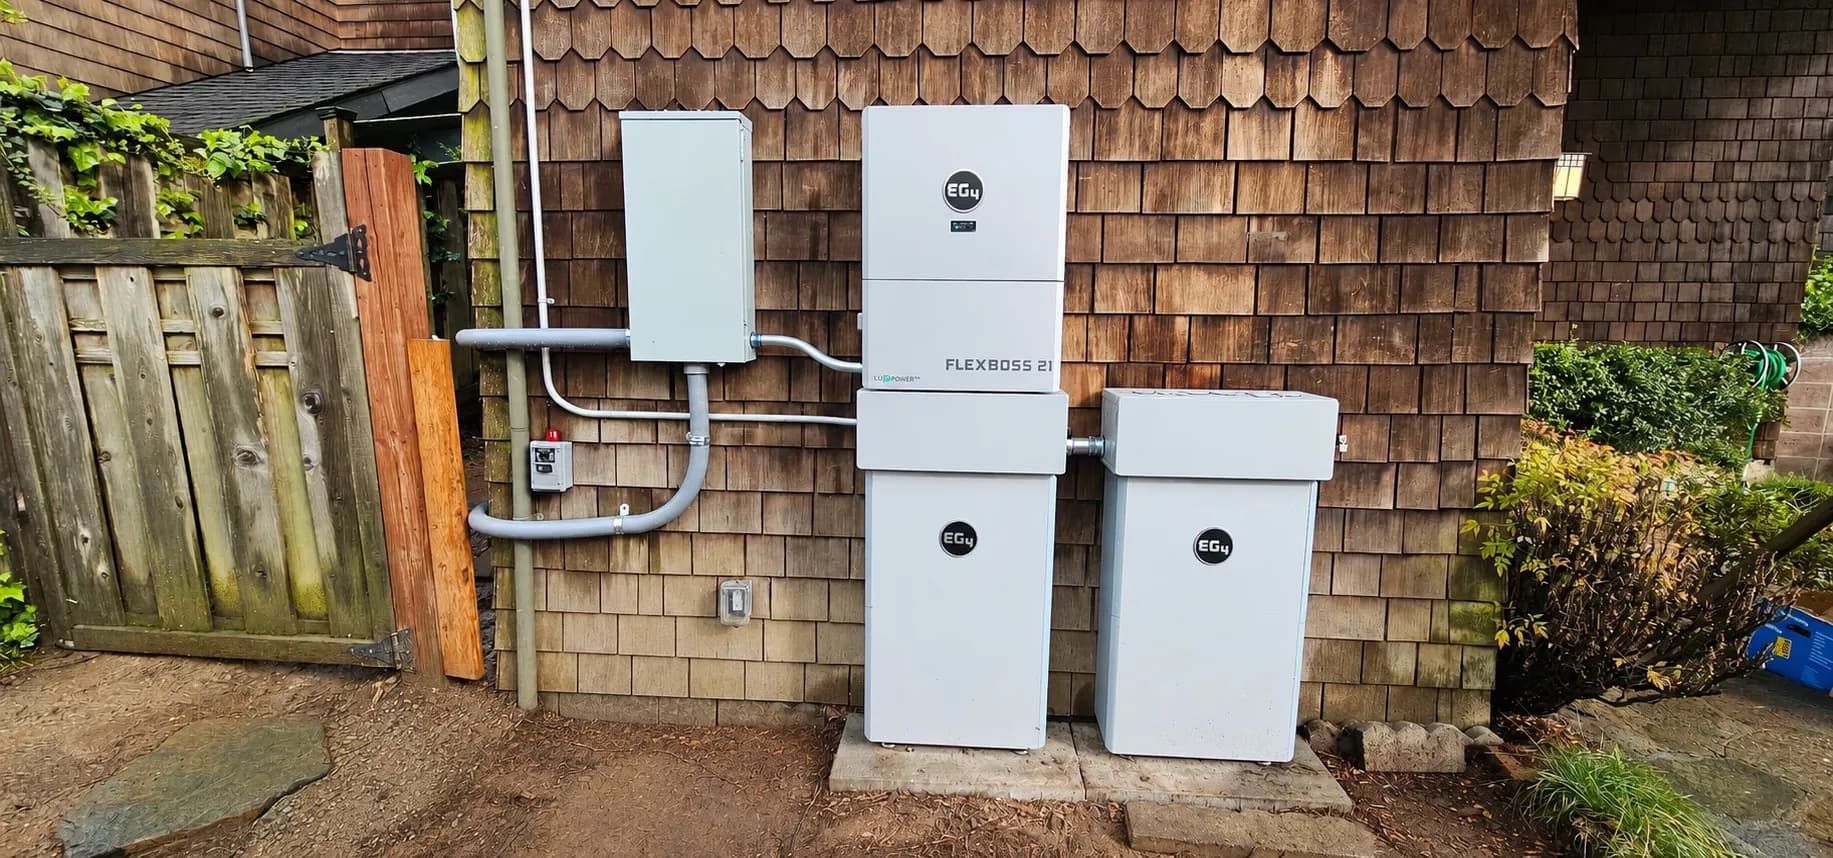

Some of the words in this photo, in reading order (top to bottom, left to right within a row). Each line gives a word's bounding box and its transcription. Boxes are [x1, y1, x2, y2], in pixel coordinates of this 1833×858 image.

[947, 183, 979, 200] EG4
[945, 358, 1032, 372] FLEXBOSS
[1037, 360, 1053, 372] 21
[943, 532, 974, 548] EG4
[1199, 540, 1229, 555] EG4
